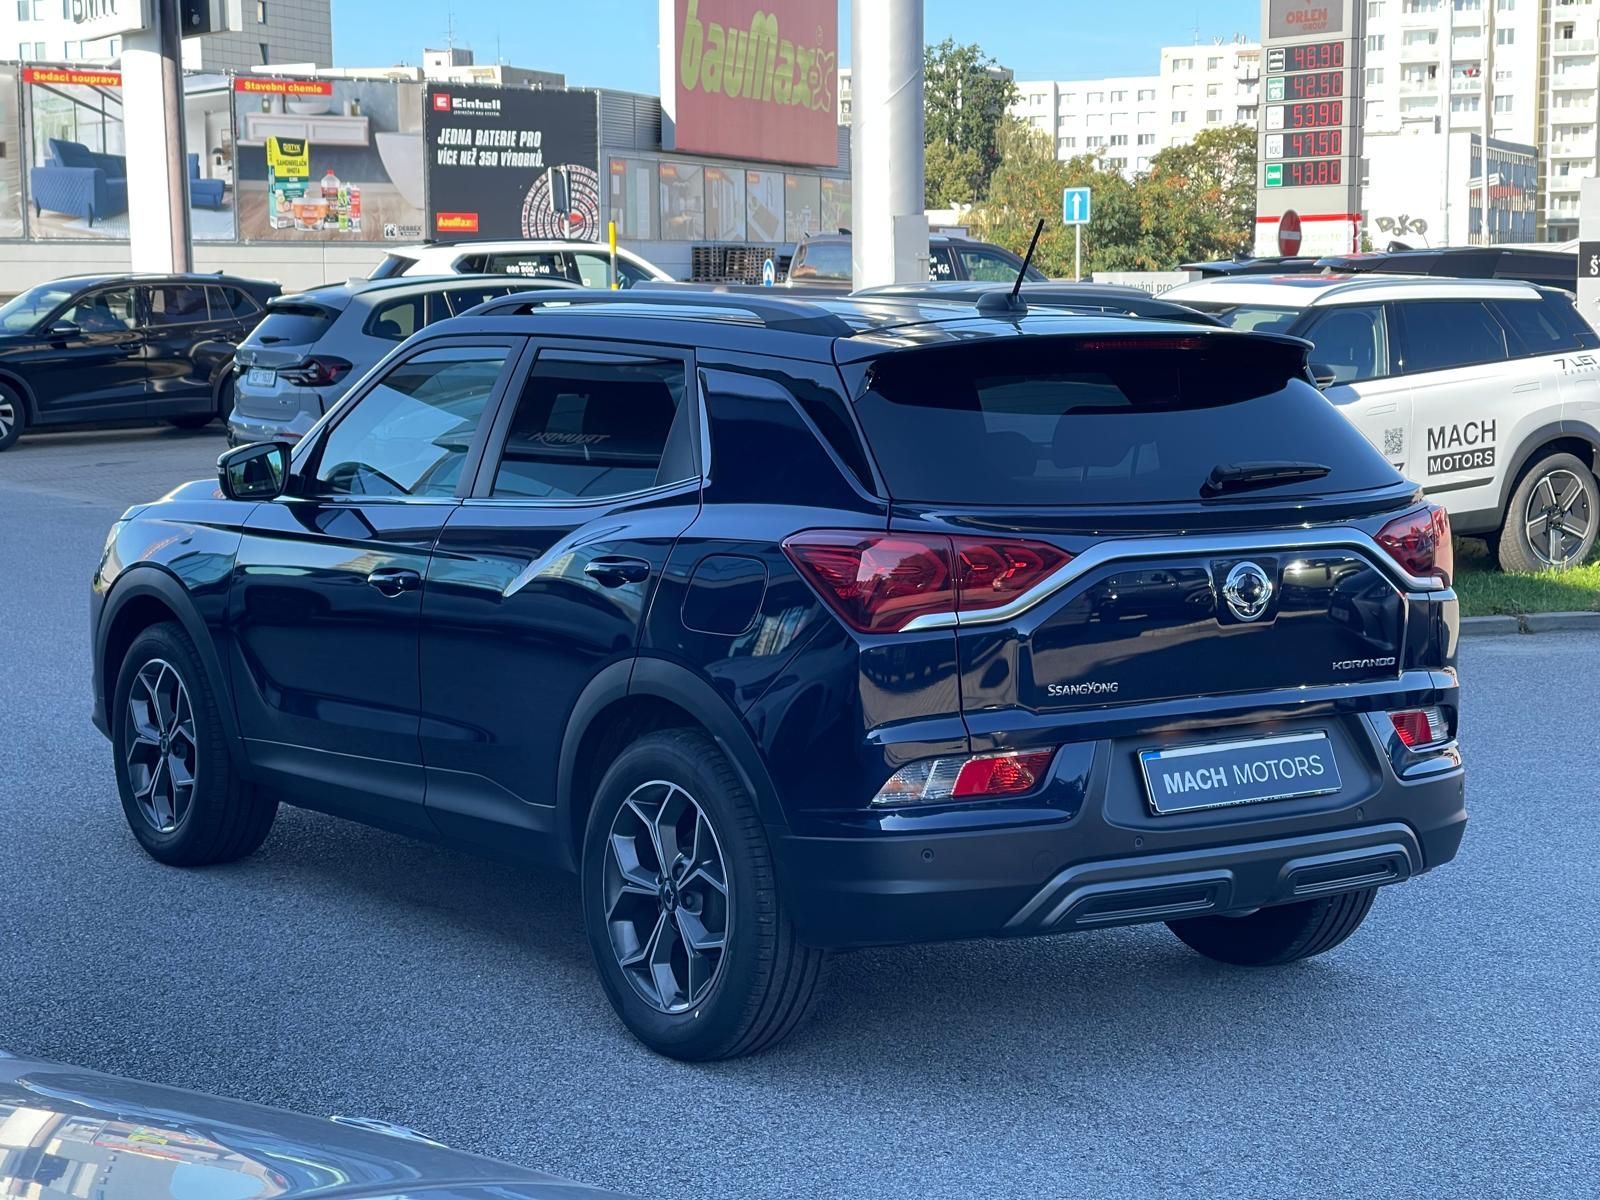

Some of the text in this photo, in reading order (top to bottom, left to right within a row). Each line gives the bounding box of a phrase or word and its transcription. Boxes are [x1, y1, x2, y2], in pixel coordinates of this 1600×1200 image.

[1286, 8, 1328, 24] ORLEN
[1303, 22, 1327, 30] GROUP
[71, 75, 119, 86] soupravy
[288, 84, 323, 93] chemie
[1294, 72, 1342, 97] 42.50
[452, 97, 501, 110] Einhell
[1293, 102, 1342, 128] 53.90
[437, 128, 542, 147] JEDNA BATERIE PRO
[1293, 131, 1341, 156] 47.50
[437, 147, 545, 167] VÍCE NEŽ 350 VÝROBKŮ.
[937, 263, 950, 275] Kč
[1590, 254, 1600, 276] Š
[1156, 283, 1173, 295] pro
[1427, 419, 1496, 452] MACH
[1430, 450, 1494, 473] MOTORS
[1332, 656, 1396, 671] KORANDO
[1162, 754, 1325, 794] MACH MOTORS
